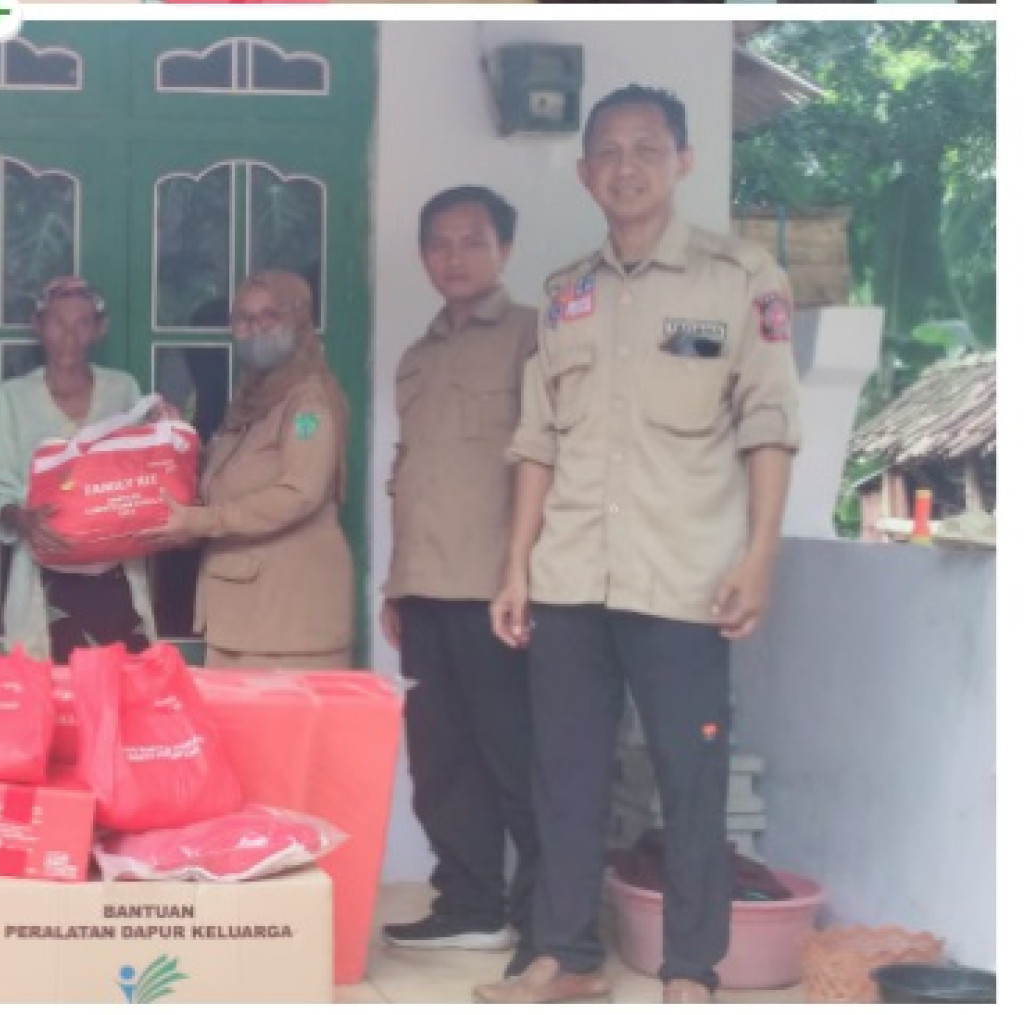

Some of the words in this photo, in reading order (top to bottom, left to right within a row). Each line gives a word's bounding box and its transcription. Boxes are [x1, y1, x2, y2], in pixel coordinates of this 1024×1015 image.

[103, 904, 194, 918] BANTUAN
[4, 926, 116, 938] PERALATAN
[121, 926, 185, 938] DAPUR
[193, 926, 294, 938] KELUARGA
